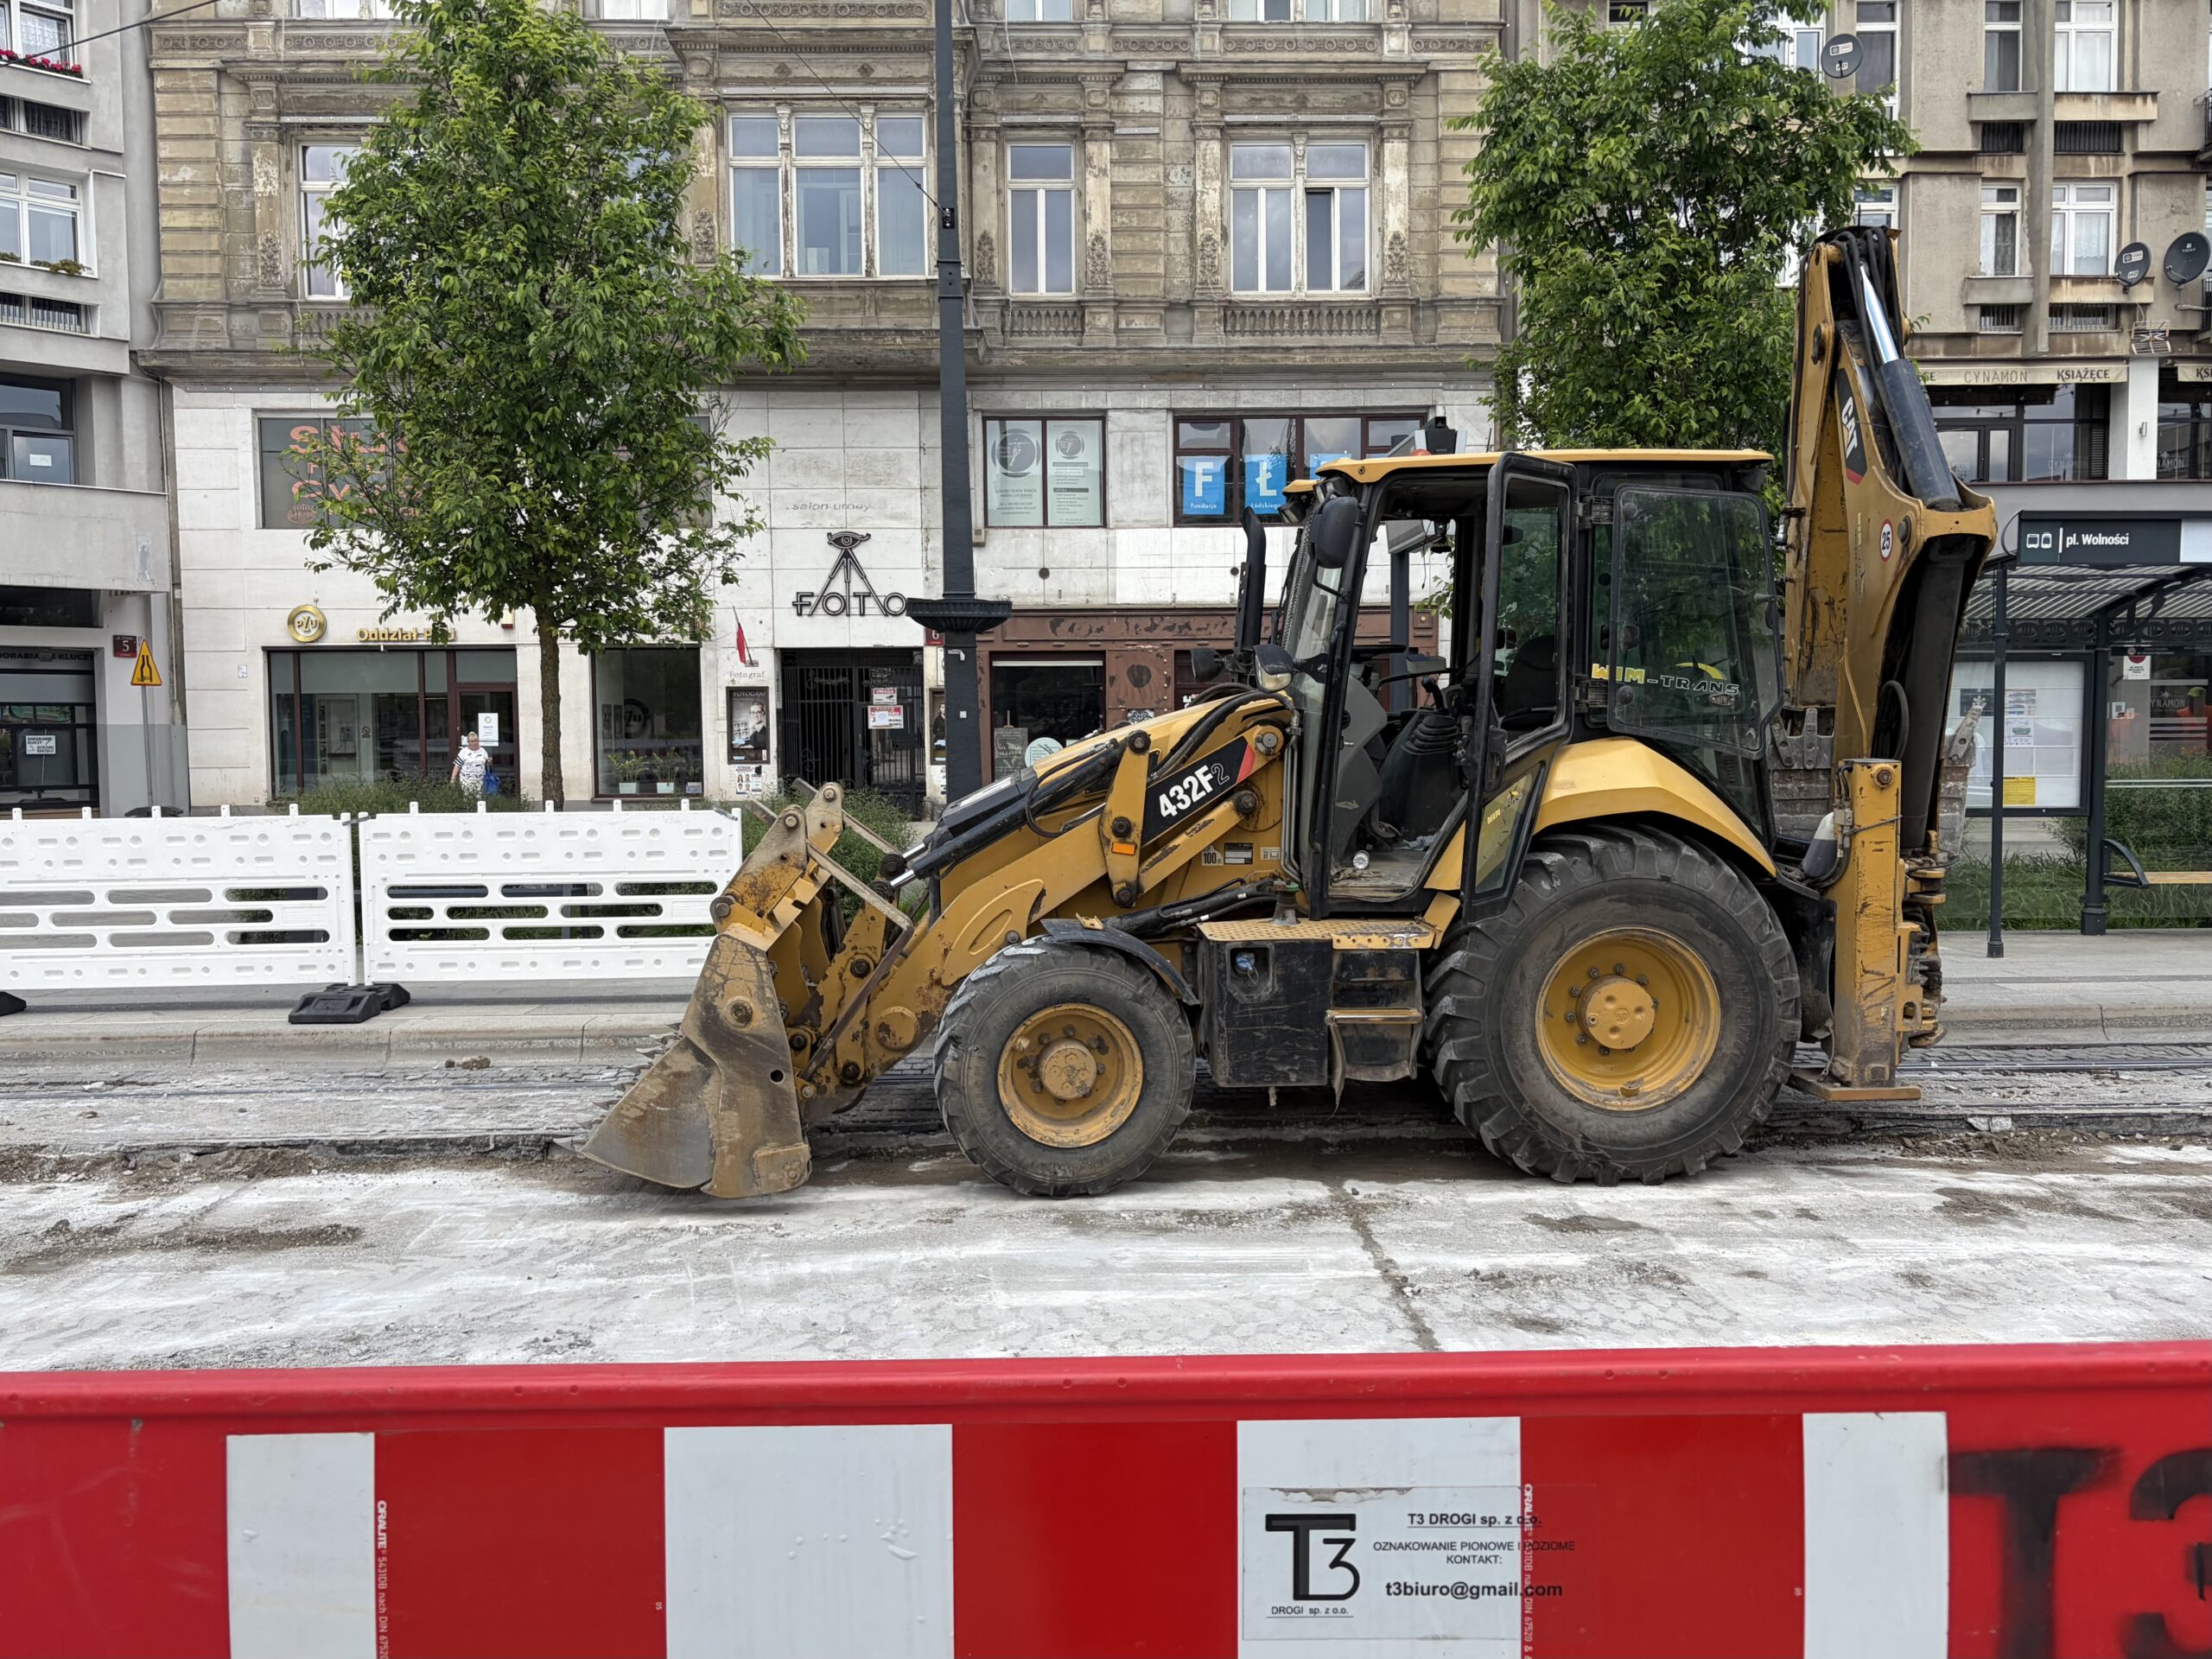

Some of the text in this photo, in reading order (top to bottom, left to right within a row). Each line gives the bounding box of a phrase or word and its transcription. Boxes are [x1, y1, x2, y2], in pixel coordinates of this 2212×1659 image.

[1964, 370, 2028, 383] CYNAMON
[2056, 367, 2110, 382] KSIĄŻĘCE
[1841, 396, 1858, 459] CAT
[1195, 461, 1213, 497] F
[1255, 461, 1277, 497] Ł
[1881, 531, 1891, 550] 25
[2066, 532, 2130, 548] pl. Wolności
[792, 592, 907, 616] FOTO
[295, 616, 318, 632] PZU
[356, 627, 417, 642] Oddział
[932, 630, 939, 639] 6
[122, 640, 130, 652] 5
[1159, 763, 1230, 817] 432F2
[1203, 852, 1217, 864] 100
[1408, 1513, 1425, 1524] T3
[1429, 1513, 1476, 1525] DROGI
[1480, 1515, 1501, 1528] sp.
[1504, 1516, 1513, 1524] z
[1373, 1541, 1458, 1551] OZNAKOWANIE
[1460, 1541, 1515, 1551] PIONOWE
[1524, 1541, 1576, 1551] POZIOME
[1265, 1514, 1361, 1600] T3
[1446, 1554, 1503, 1564] KONTAKT:
[1385, 1581, 1563, 1599] t3biuro@gmail.com
[1271, 1605, 1304, 1615] DROGI
[1309, 1606, 1322, 1616] sp.
[379, 1616, 388, 1633] DIN
